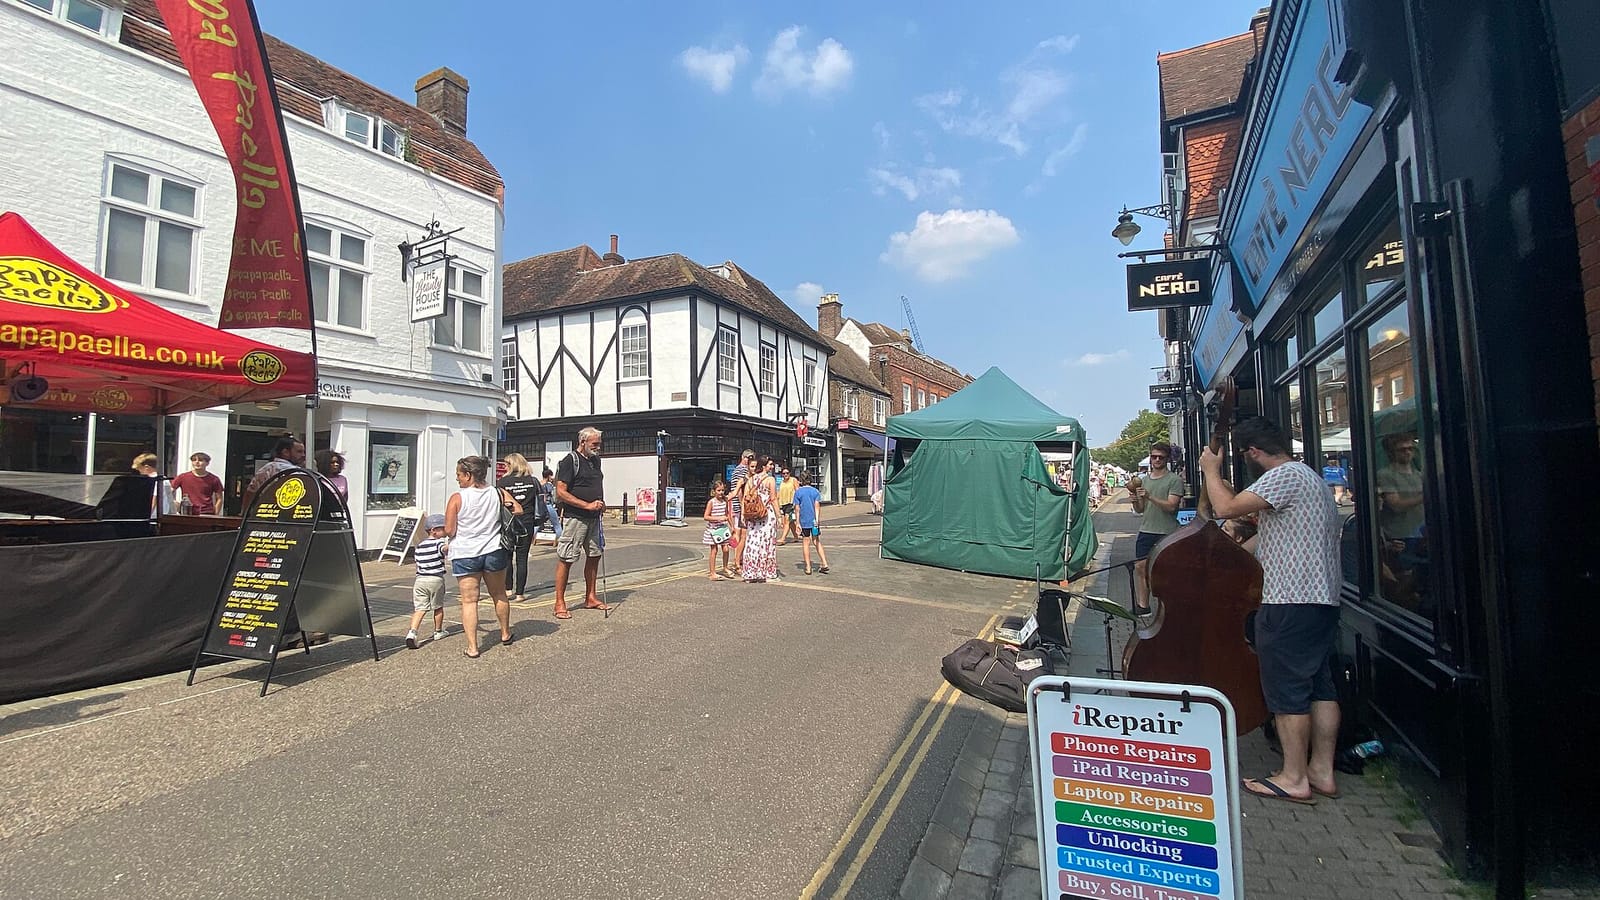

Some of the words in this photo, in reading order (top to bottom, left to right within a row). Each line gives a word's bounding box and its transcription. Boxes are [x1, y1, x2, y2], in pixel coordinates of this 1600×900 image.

[423, 269, 436, 281] THE
[1139, 280, 1200, 298] NERO
[416, 290, 440, 305] HOUSE
[1072, 704, 1183, 736] iRepair
[1063, 736, 1119, 755] Phone
[1124, 743, 1197, 764] Repairs
[1072, 760, 1113, 778] iPad
[1117, 765, 1190, 787] Repairs
[1063, 782, 1125, 804] Laptop
[1129, 790, 1203, 813] Repairs
[1080, 809, 1188, 837] Accessories
[1087, 831, 1183, 861] Unlocking
[1064, 850, 1134, 874] Trusted
[1139, 863, 1213, 887] Experts
[1066, 874, 1106, 895] Buy,
[1110, 882, 1149, 900] Sell,
